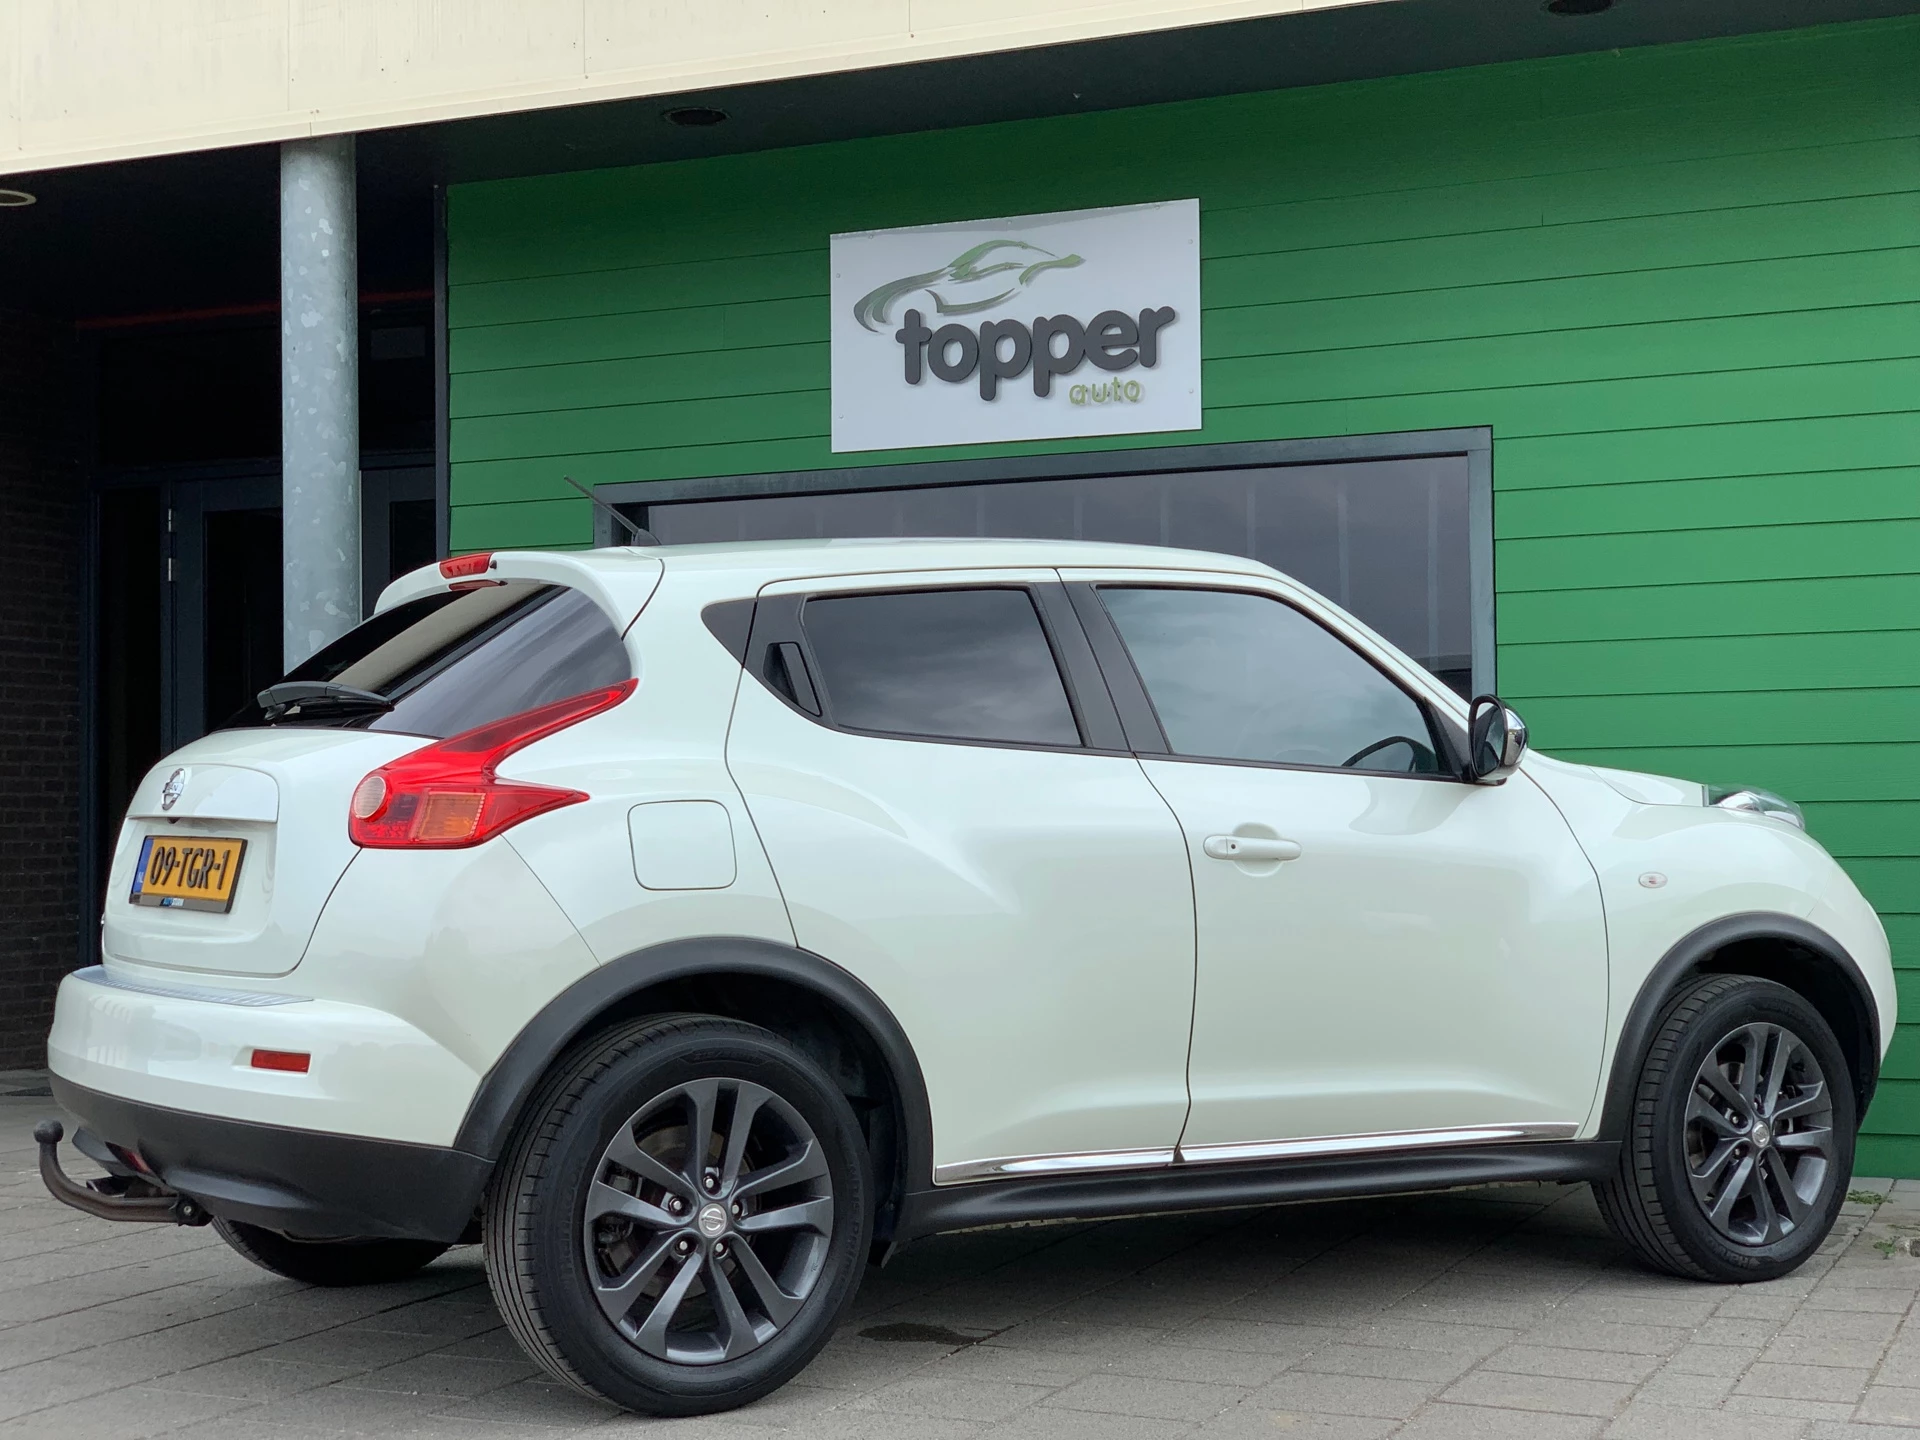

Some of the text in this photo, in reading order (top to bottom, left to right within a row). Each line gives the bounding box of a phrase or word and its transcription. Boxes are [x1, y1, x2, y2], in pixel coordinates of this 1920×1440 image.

[895, 306, 1175, 401] topper
[1069, 376, 1140, 405] auto
[150, 846, 231, 890] 09-TGR-1
